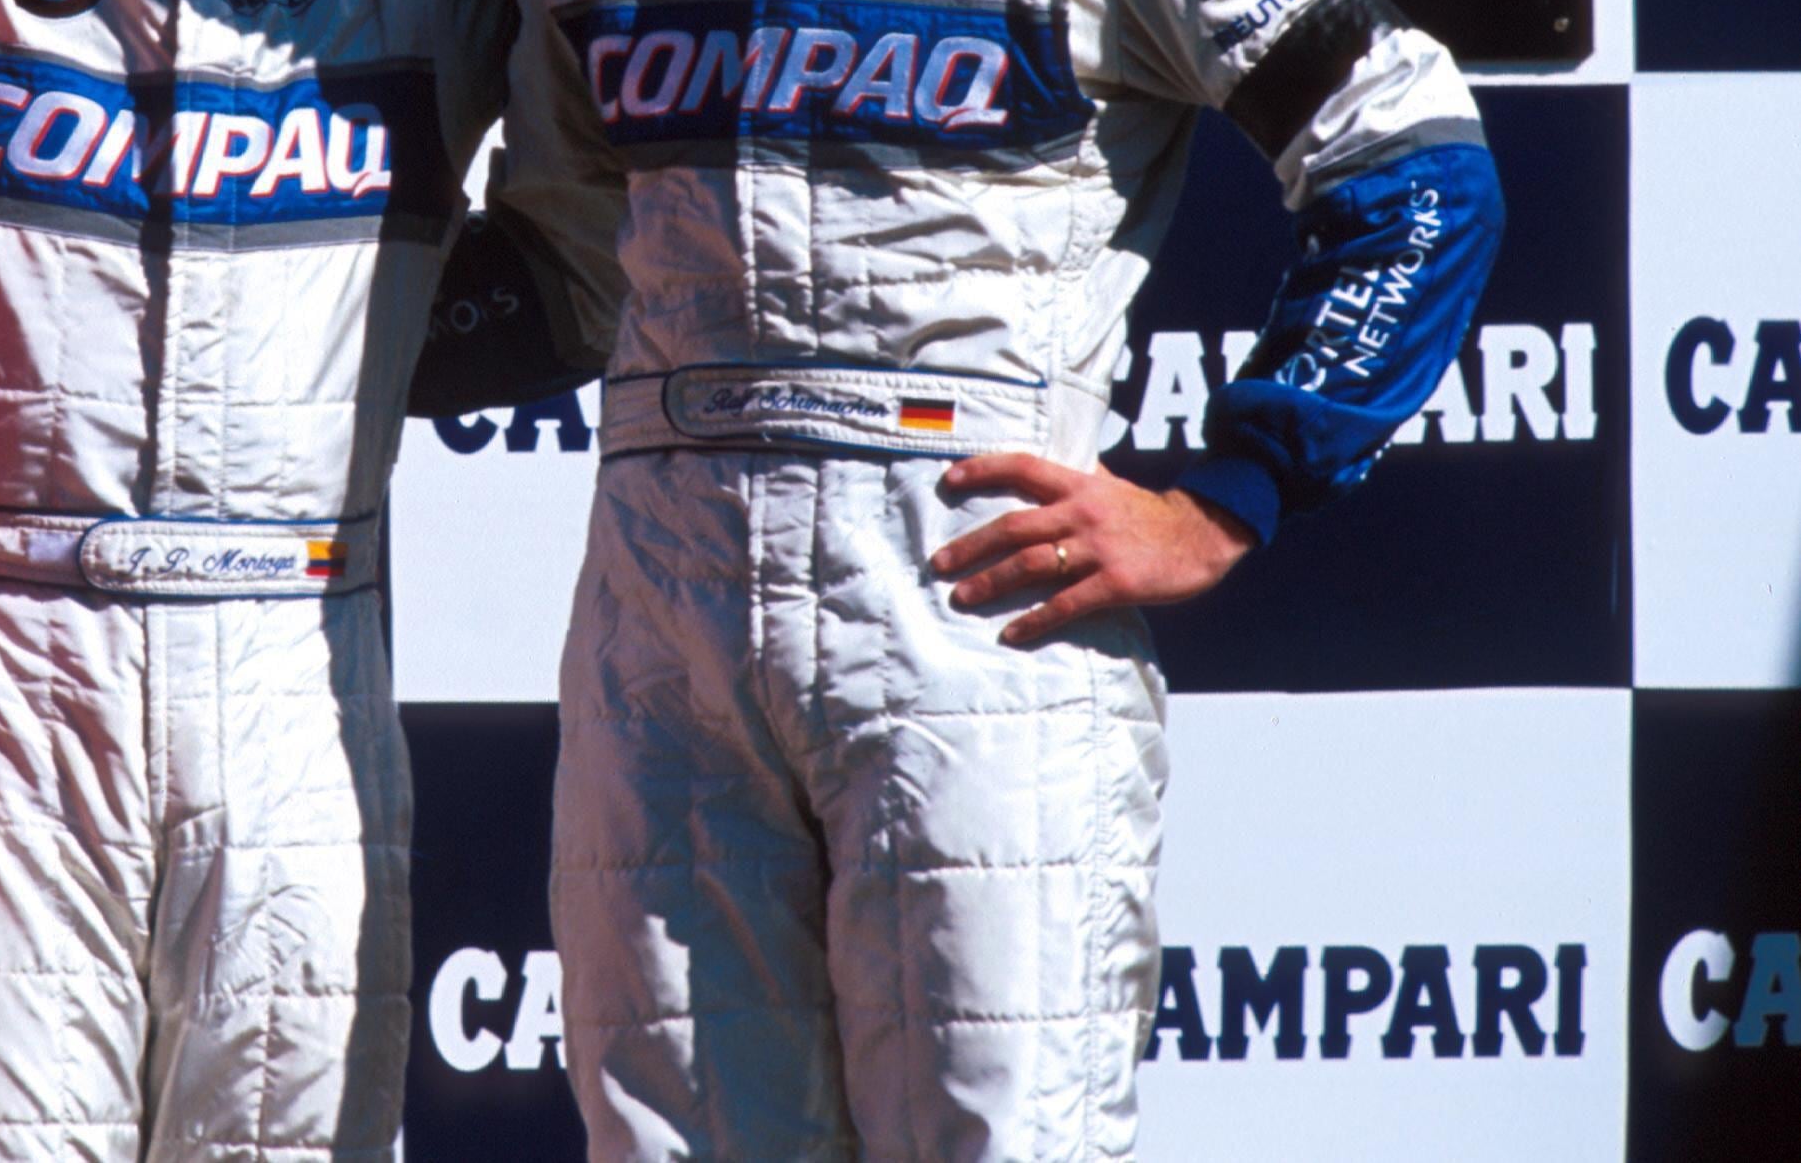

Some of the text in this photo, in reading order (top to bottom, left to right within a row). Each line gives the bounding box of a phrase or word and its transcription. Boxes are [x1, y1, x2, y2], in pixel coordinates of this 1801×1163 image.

[587, 26, 1008, 132] COMPAQ
[1342, 187, 1444, 378] NETWORKS
[1663, 316, 1801, 434] CA
[1659, 929, 1801, 1051] CA
